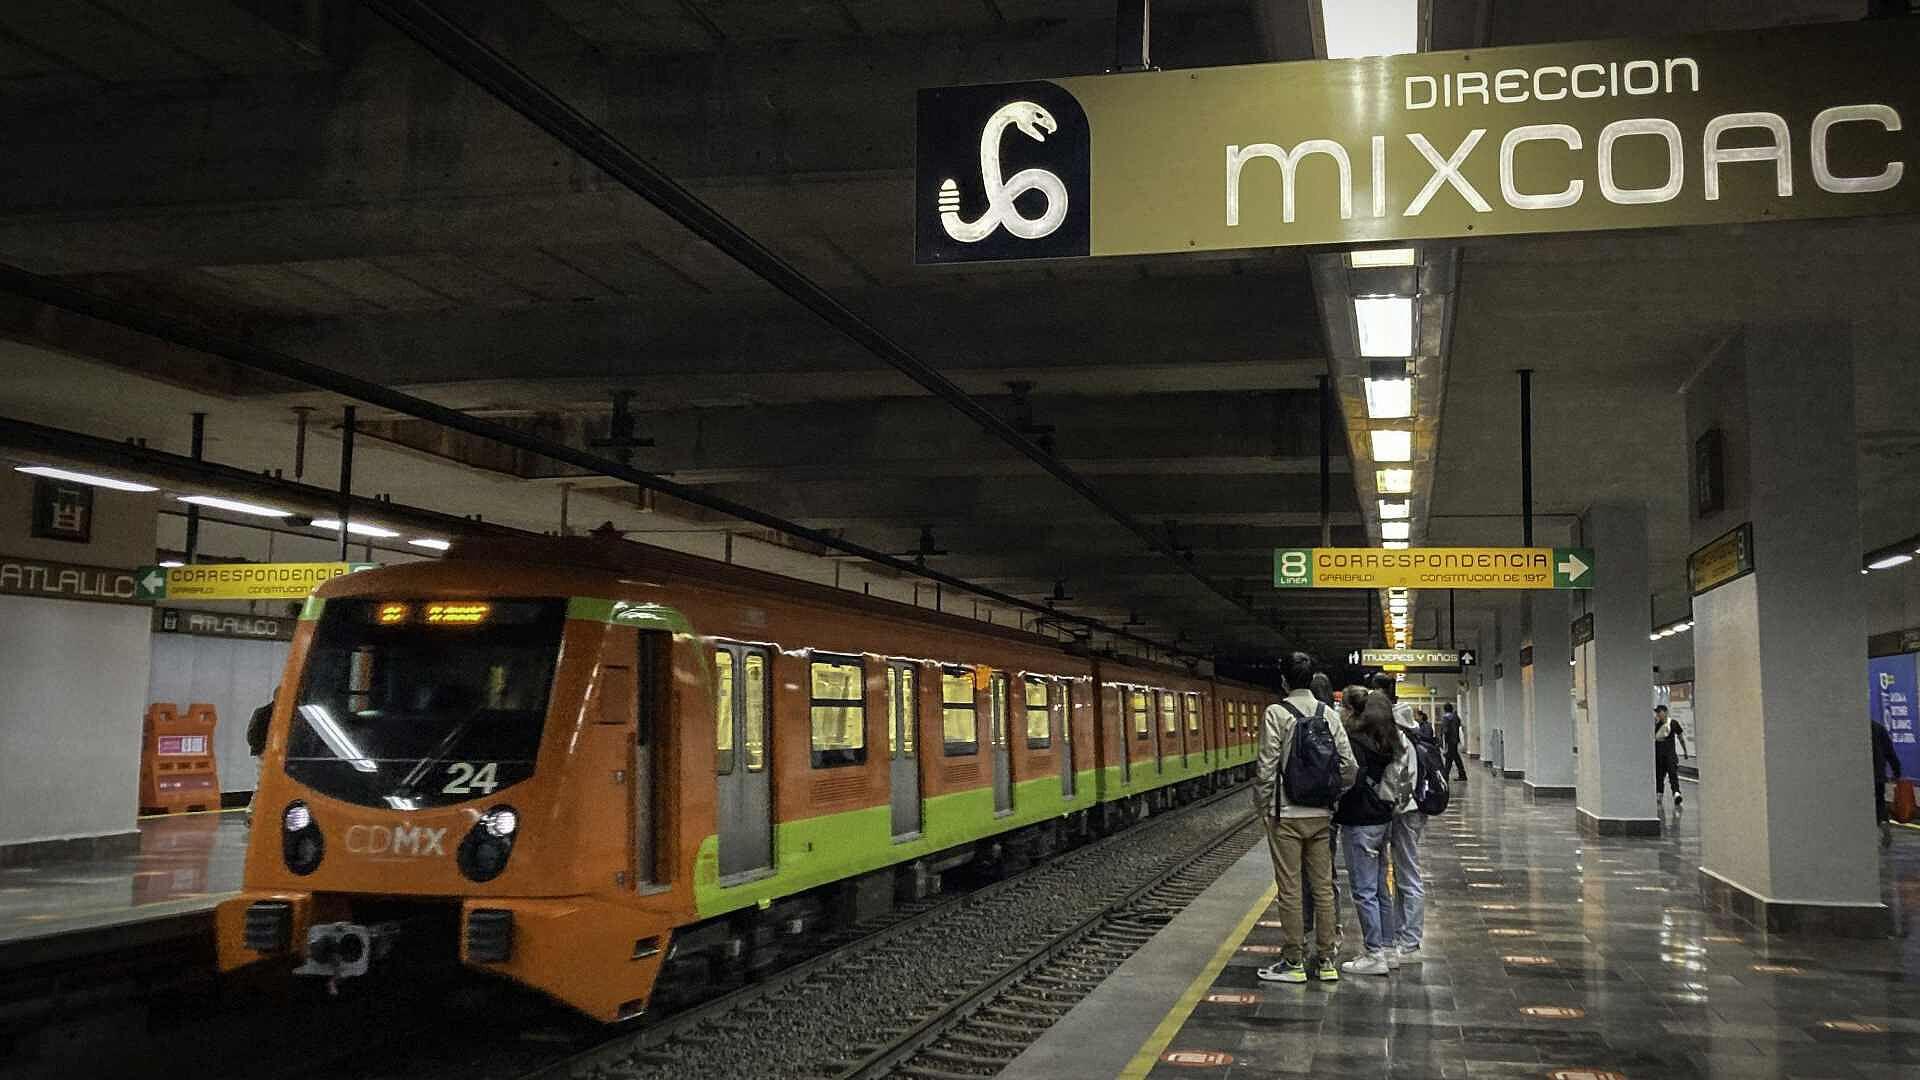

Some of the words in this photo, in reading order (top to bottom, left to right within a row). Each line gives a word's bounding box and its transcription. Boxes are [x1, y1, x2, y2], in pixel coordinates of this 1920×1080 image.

[1405, 56, 1700, 110] DIRECCION
[1226, 102, 1905, 228] MIXCOAC
[1281, 551, 1306, 577] 8
[1318, 554, 1548, 569] CORRESPONDENCIA
[0, 563, 137, 598] ATLALILC
[1280, 576, 1308, 585] LINEA
[1319, 573, 1376, 583] GARIBALDI
[1420, 573, 1500, 583] CONSTITUCION
[1503, 573, 1520, 583] DE
[1523, 573, 1547, 583] 1917
[1362, 653, 1415, 662] MUJERES
[1416, 653, 1425, 662] Y
[1427, 652, 1458, 662] NIÑOS
[443, 761, 500, 794] 24
[344, 822, 448, 856] CDMX
